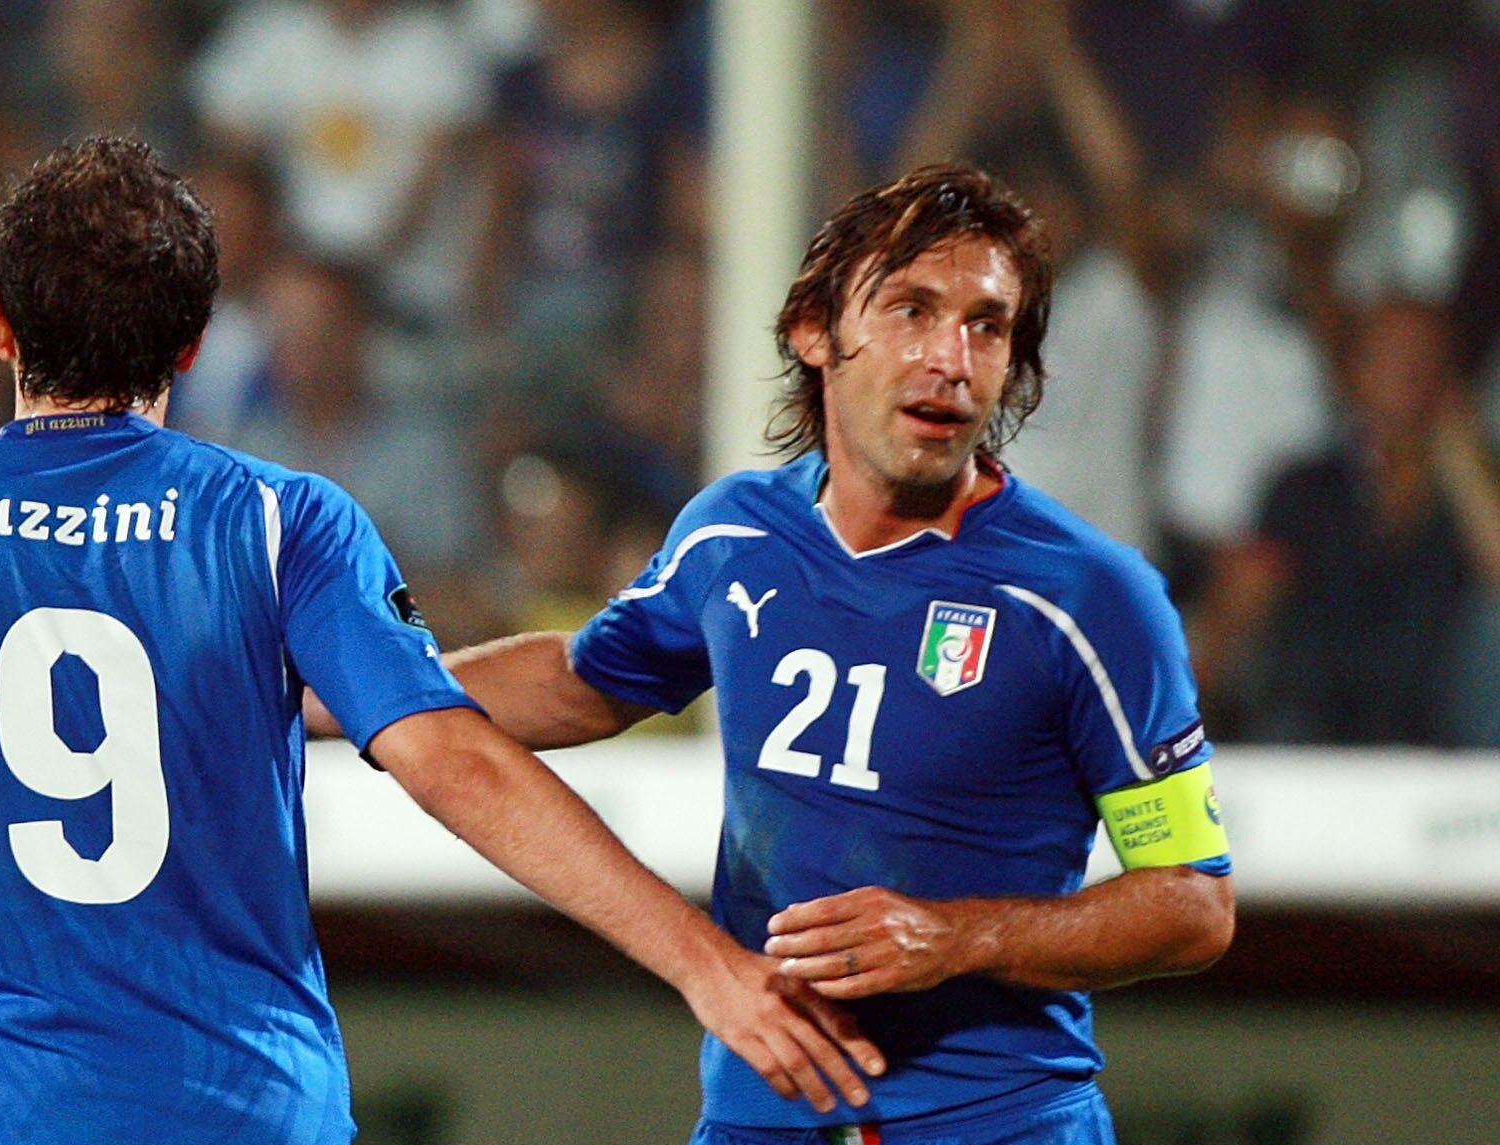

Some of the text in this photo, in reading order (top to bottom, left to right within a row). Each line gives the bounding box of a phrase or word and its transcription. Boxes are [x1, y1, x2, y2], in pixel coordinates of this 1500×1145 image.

[25, 418, 45, 436] gli
[936, 610, 985, 627] ITALIA
[757, 648, 888, 791] 21
[1112, 797, 1166, 822] UNITE
[1122, 828, 1172, 849] RACISM
